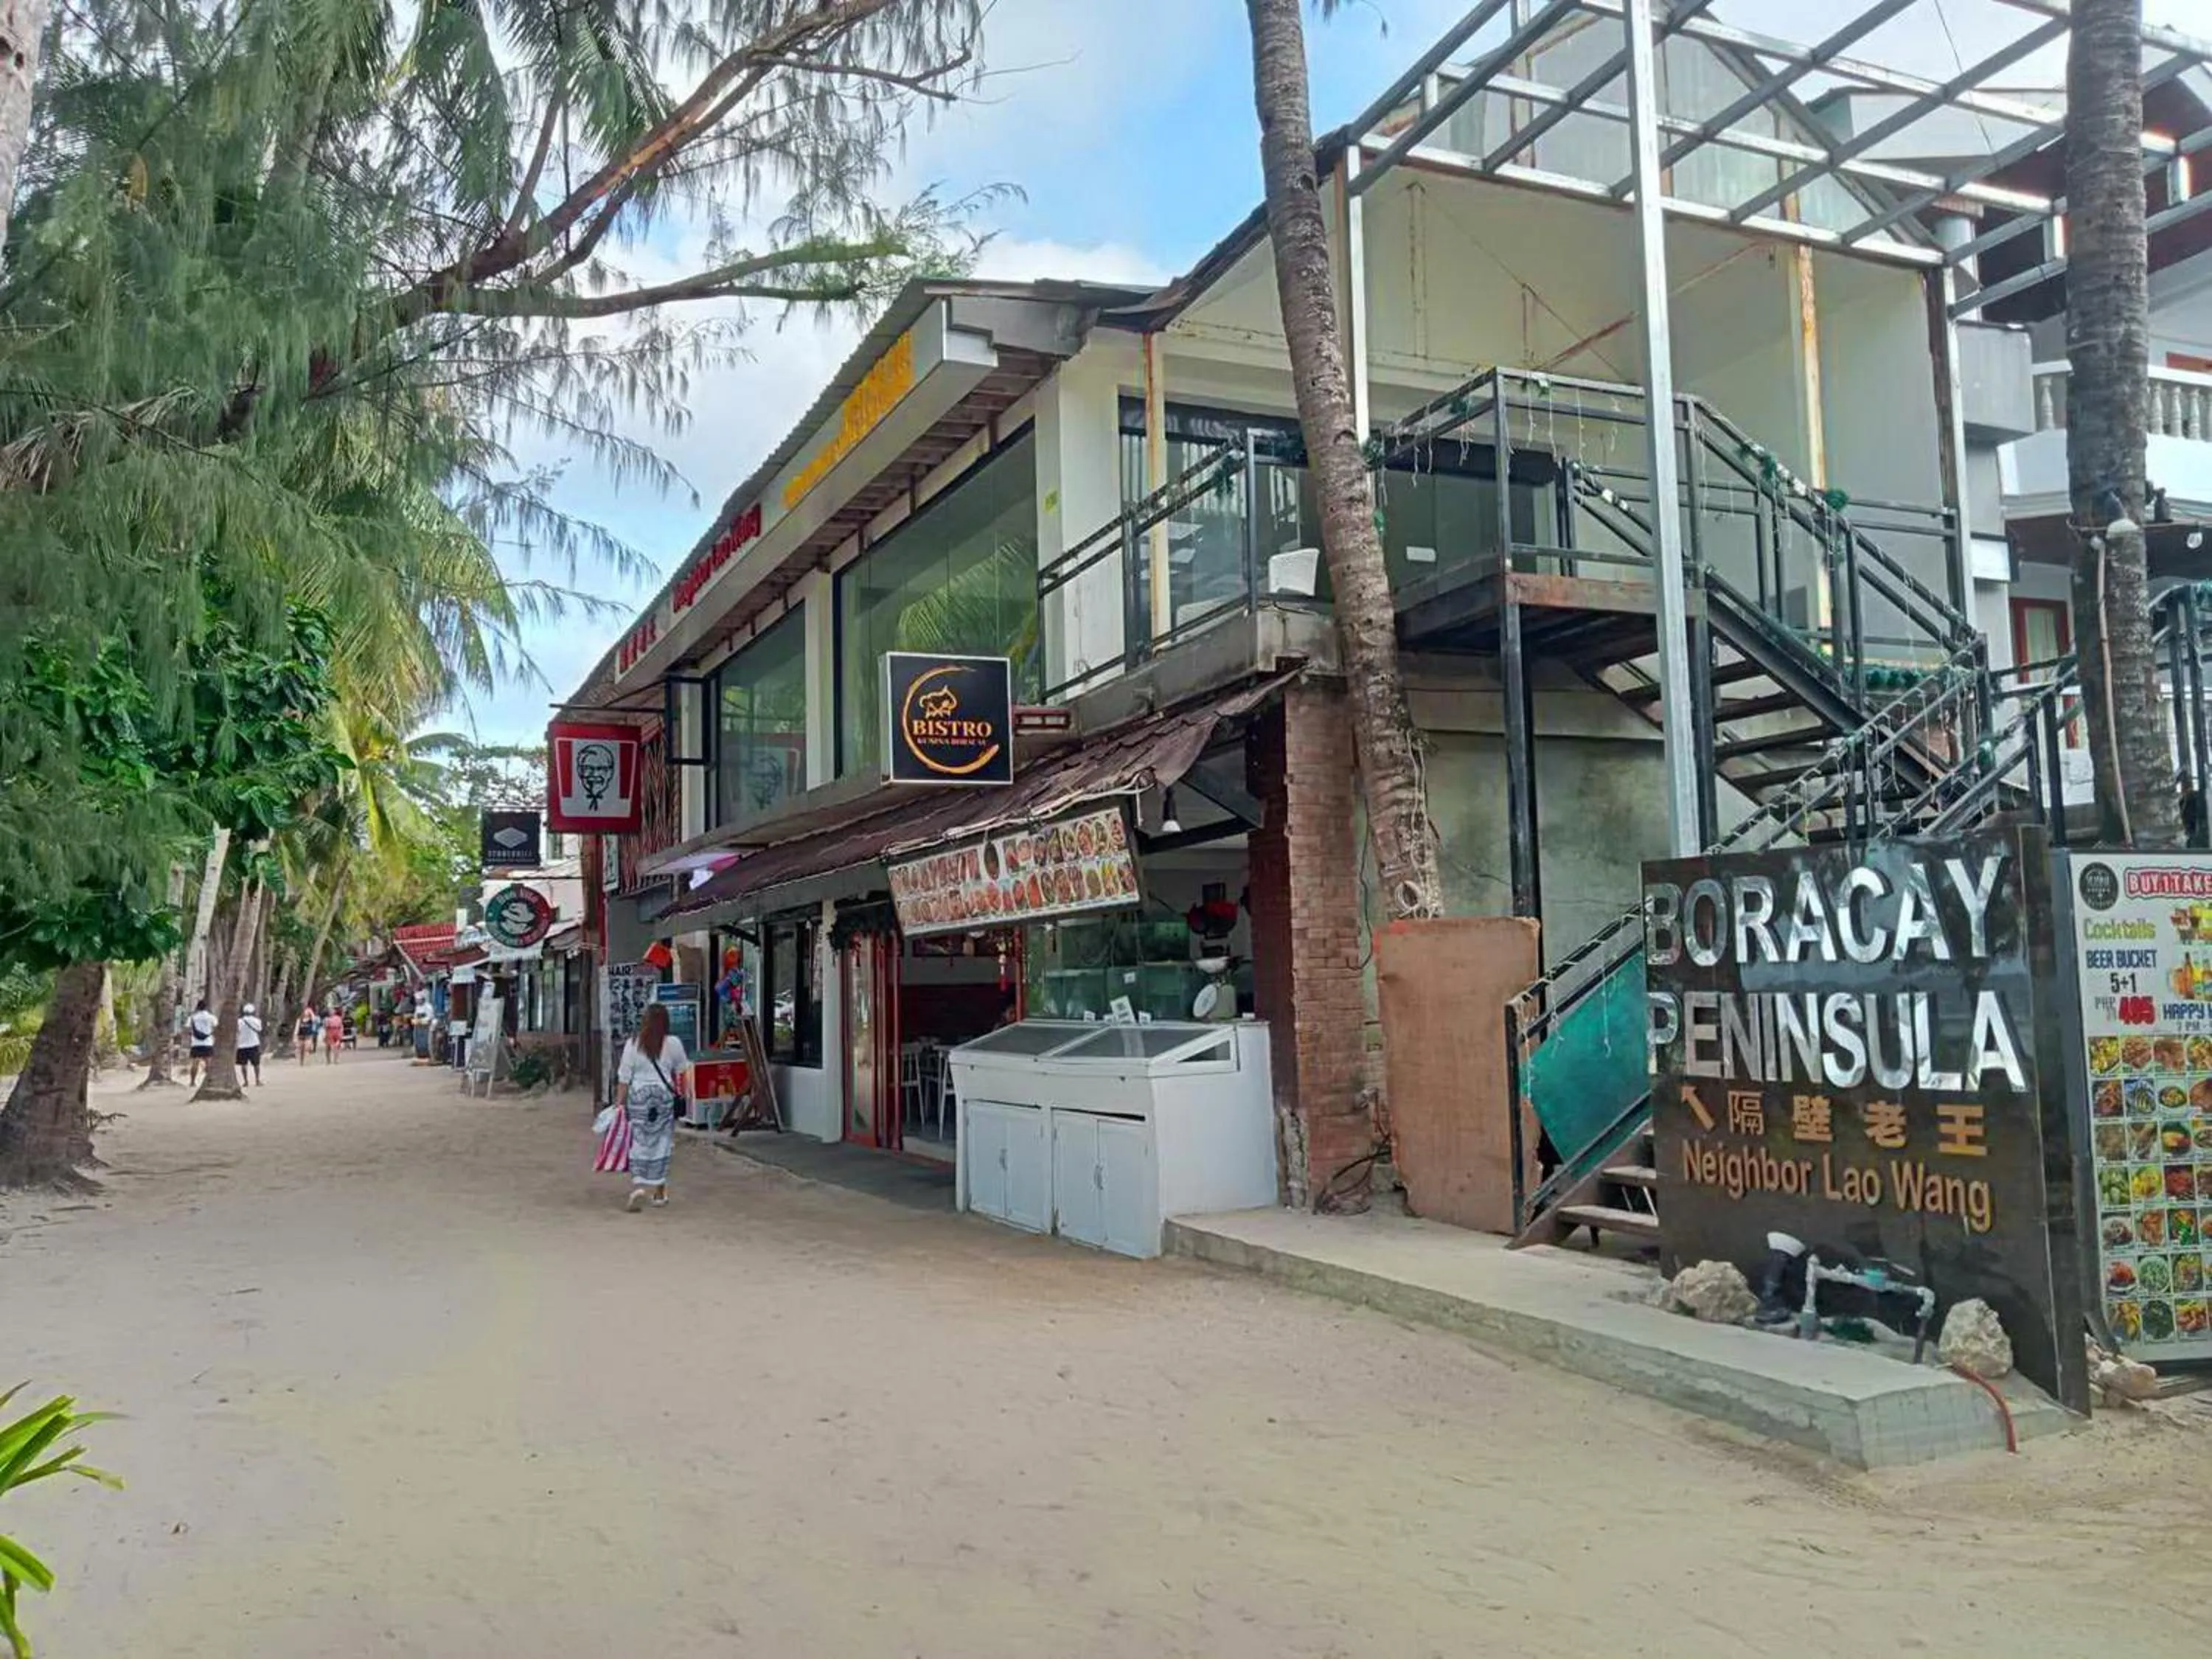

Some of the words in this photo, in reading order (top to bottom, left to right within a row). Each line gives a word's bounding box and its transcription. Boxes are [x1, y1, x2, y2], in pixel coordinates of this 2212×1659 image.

[913, 720, 992, 737] BISTRO
[2129, 873, 2158, 891] BUY
[1646, 857, 2003, 966] BORACAY
[2086, 950, 2114, 969] BEER
[2115, 949, 2157, 968] BUCKET
[2110, 972, 2137, 993] 5+1
[2163, 1004, 2204, 1020] HAPPY
[1646, 991, 2029, 1092] PENINSULA
[1727, 1091, 1988, 1156] 隔壁老王
[1682, 1139, 1812, 1200] Neighbor
[1823, 1153, 1882, 1206] Lao
[1891, 1160, 1992, 1233] Wang
